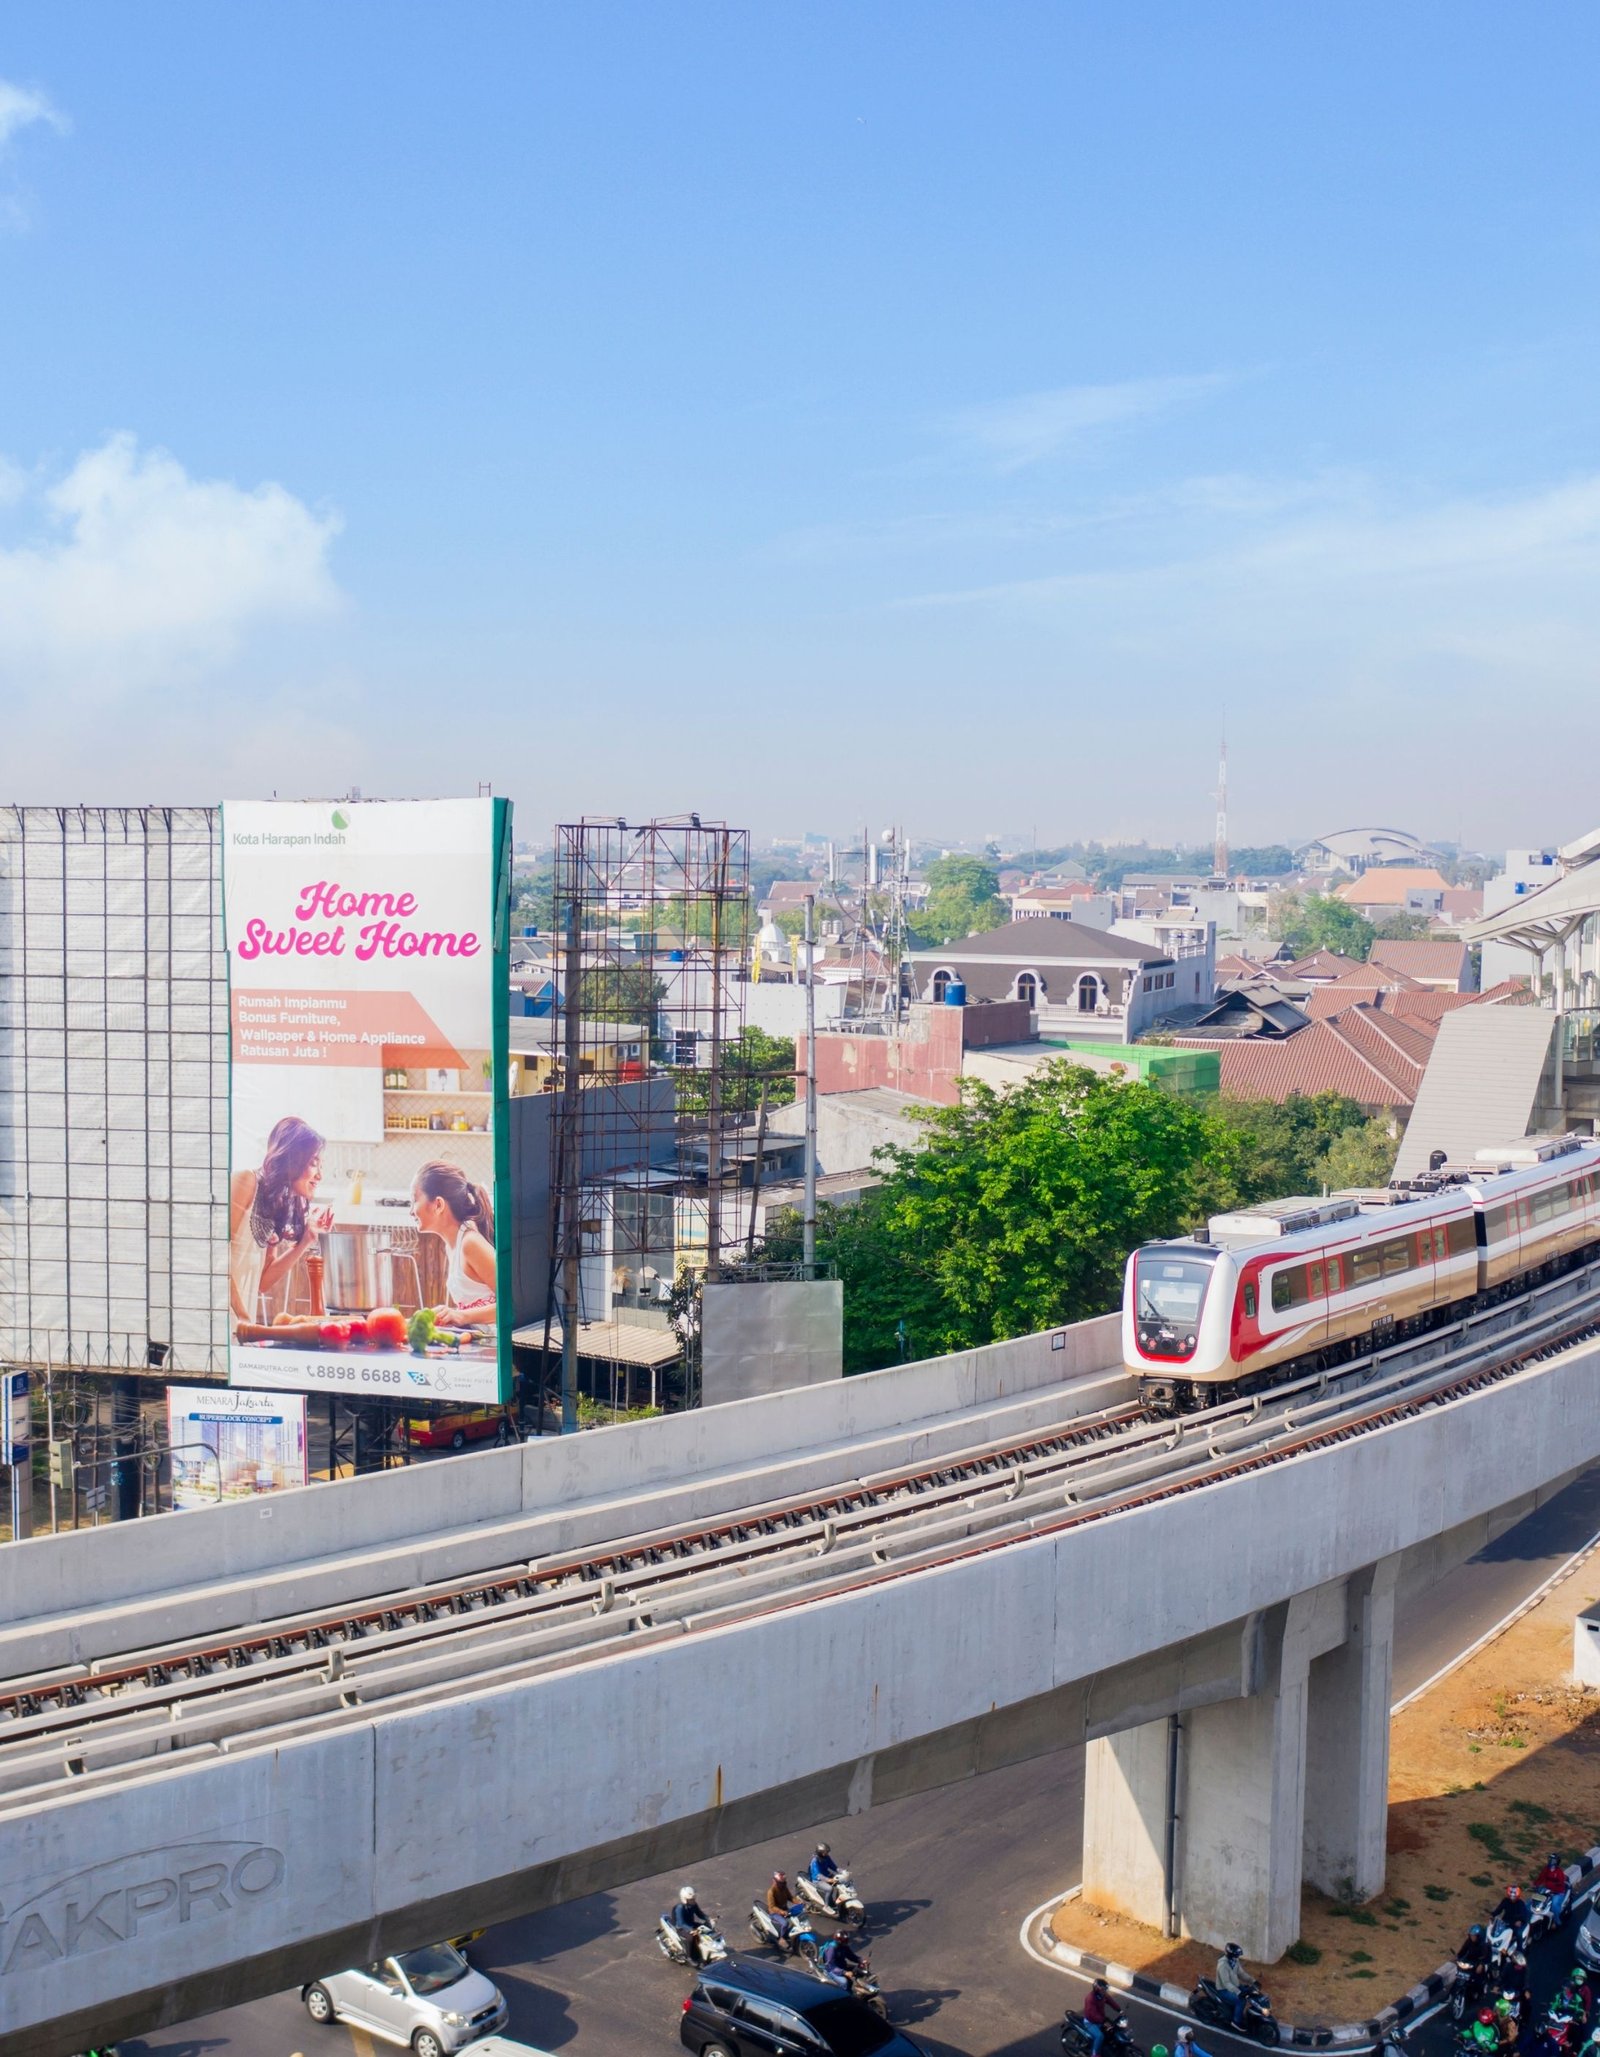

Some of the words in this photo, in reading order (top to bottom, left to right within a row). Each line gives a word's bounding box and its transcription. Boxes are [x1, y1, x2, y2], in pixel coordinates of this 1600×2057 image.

[233, 833, 259, 845] Kota
[262, 833, 311, 848] Harapan
[314, 833, 346, 845] Indah
[295, 881, 419, 921] Home
[238, 918, 346, 960] Sweet
[355, 920, 481, 961] Home
[238, 995, 281, 1008] Rumah
[284, 996, 347, 1010] Impianmu
[239, 1012, 277, 1024] Bonus
[280, 1012, 341, 1026] Furniture,
[240, 1029, 304, 1044] Wallpaper
[307, 1031, 315, 1042] &
[319, 1031, 356, 1043] Home
[361, 1032, 426, 1046] Appliance
[240, 1045, 289, 1057] Ratusan
[293, 1046, 320, 1058] Juta
[322, 1047, 327, 1058] !
[238, 1362, 299, 1373] DAMAIPUTRA.COM
[316, 1365, 356, 1380] 8898
[361, 1368, 401, 1383] 6688
[196, 1395, 233, 1406] MENARA
[199, 1414, 241, 1422] SUPERBLOCK
[242, 1415, 273, 1423] CONCEPT
[0, 1847, 286, 1976] AKPRO
